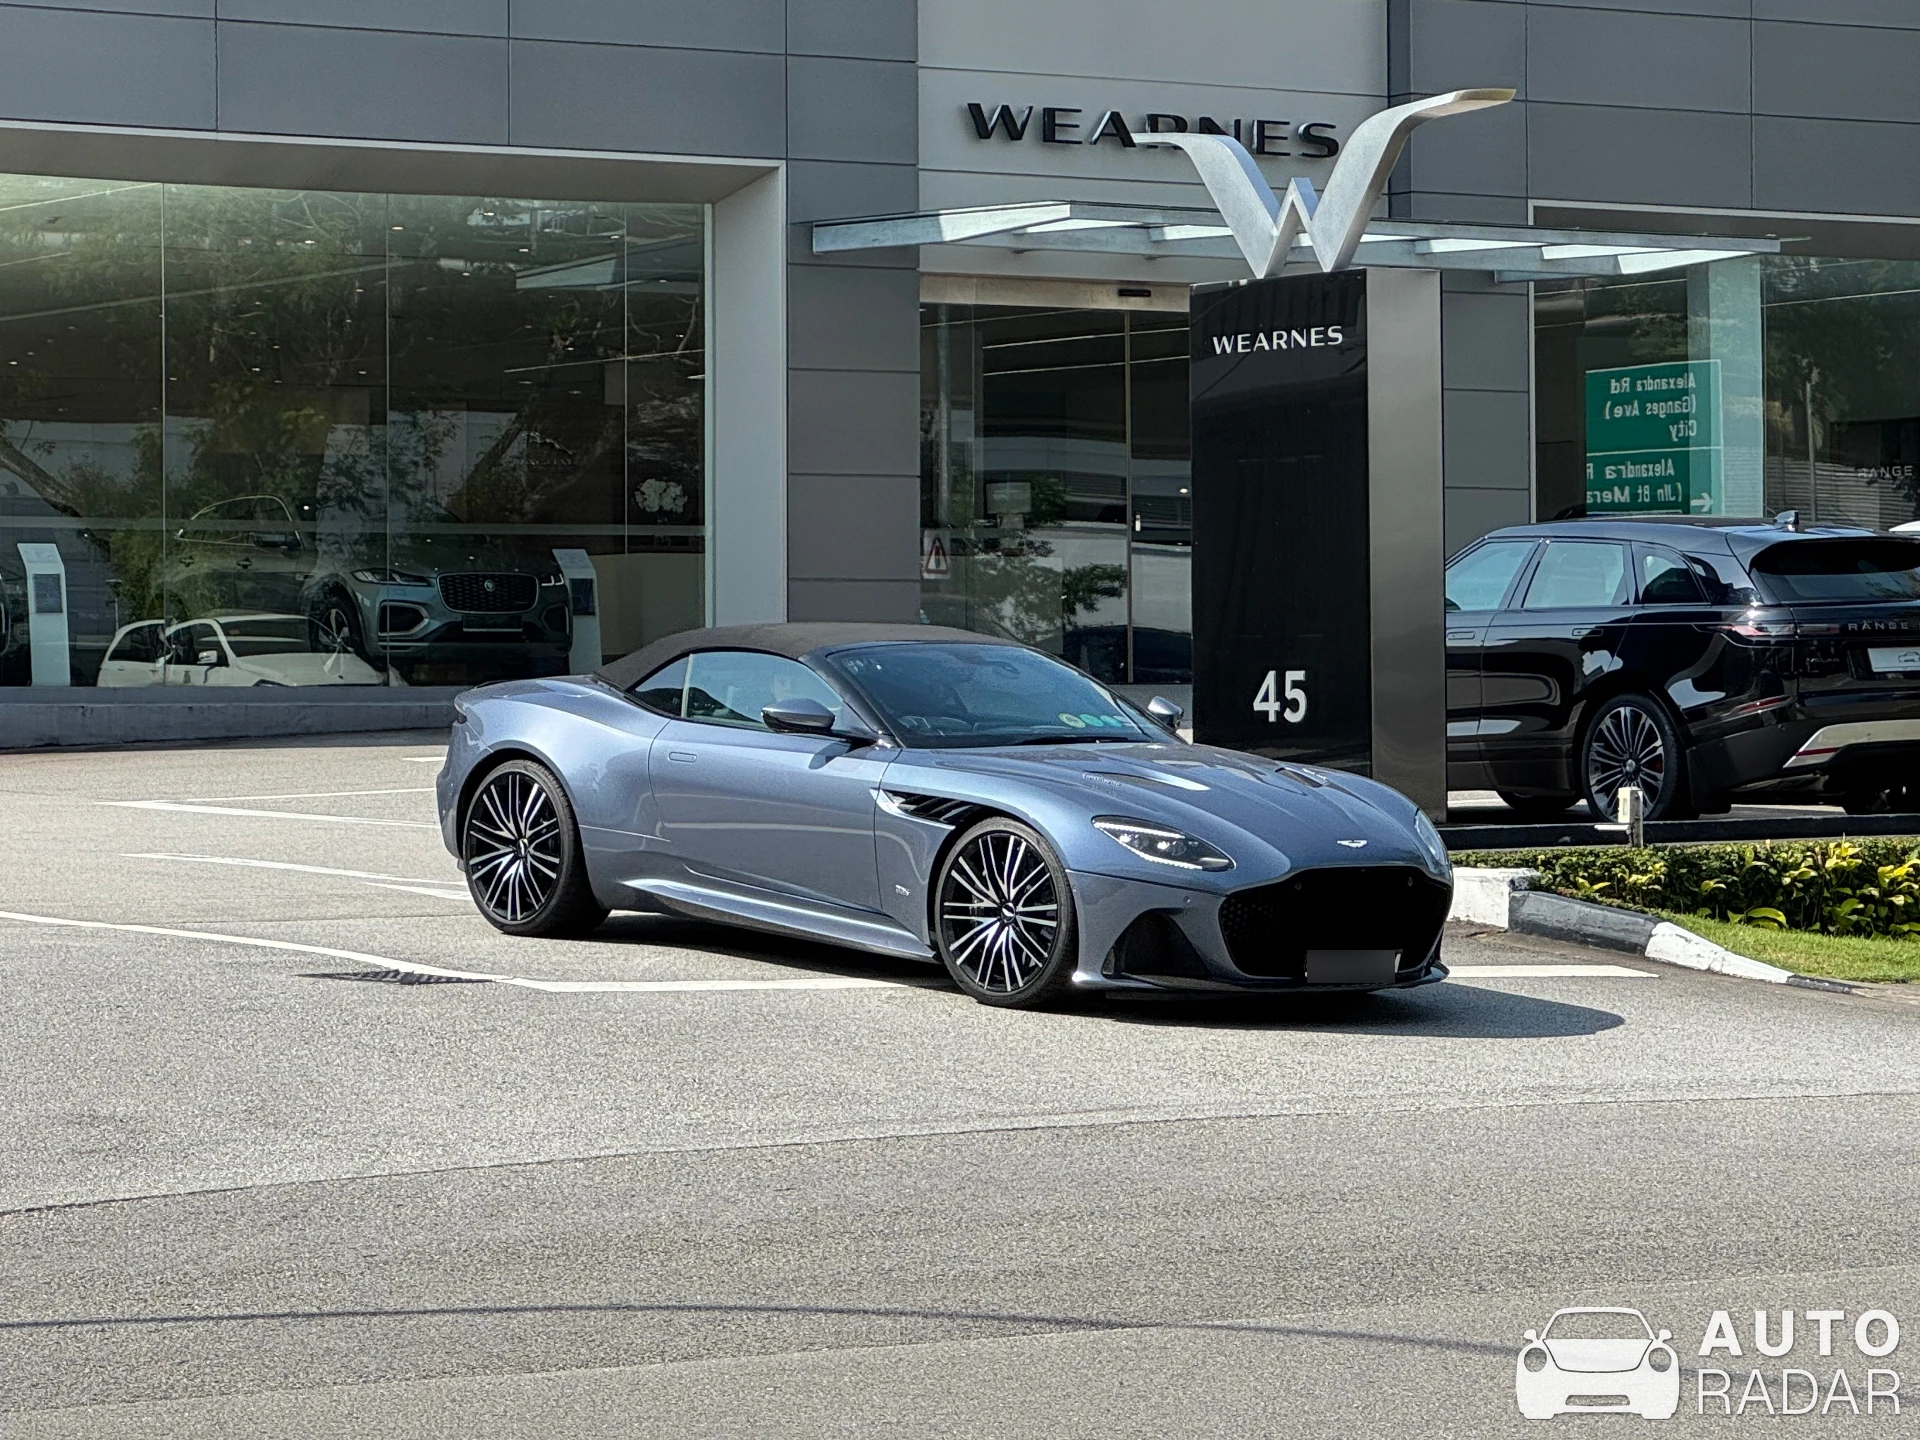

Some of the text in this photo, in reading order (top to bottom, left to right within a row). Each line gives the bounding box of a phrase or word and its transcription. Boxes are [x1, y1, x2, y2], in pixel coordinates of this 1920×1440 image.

[1212, 326, 1344, 356] WEARNES
[1848, 621, 1909, 630] RANGE
[1253, 670, 1307, 722] 45
